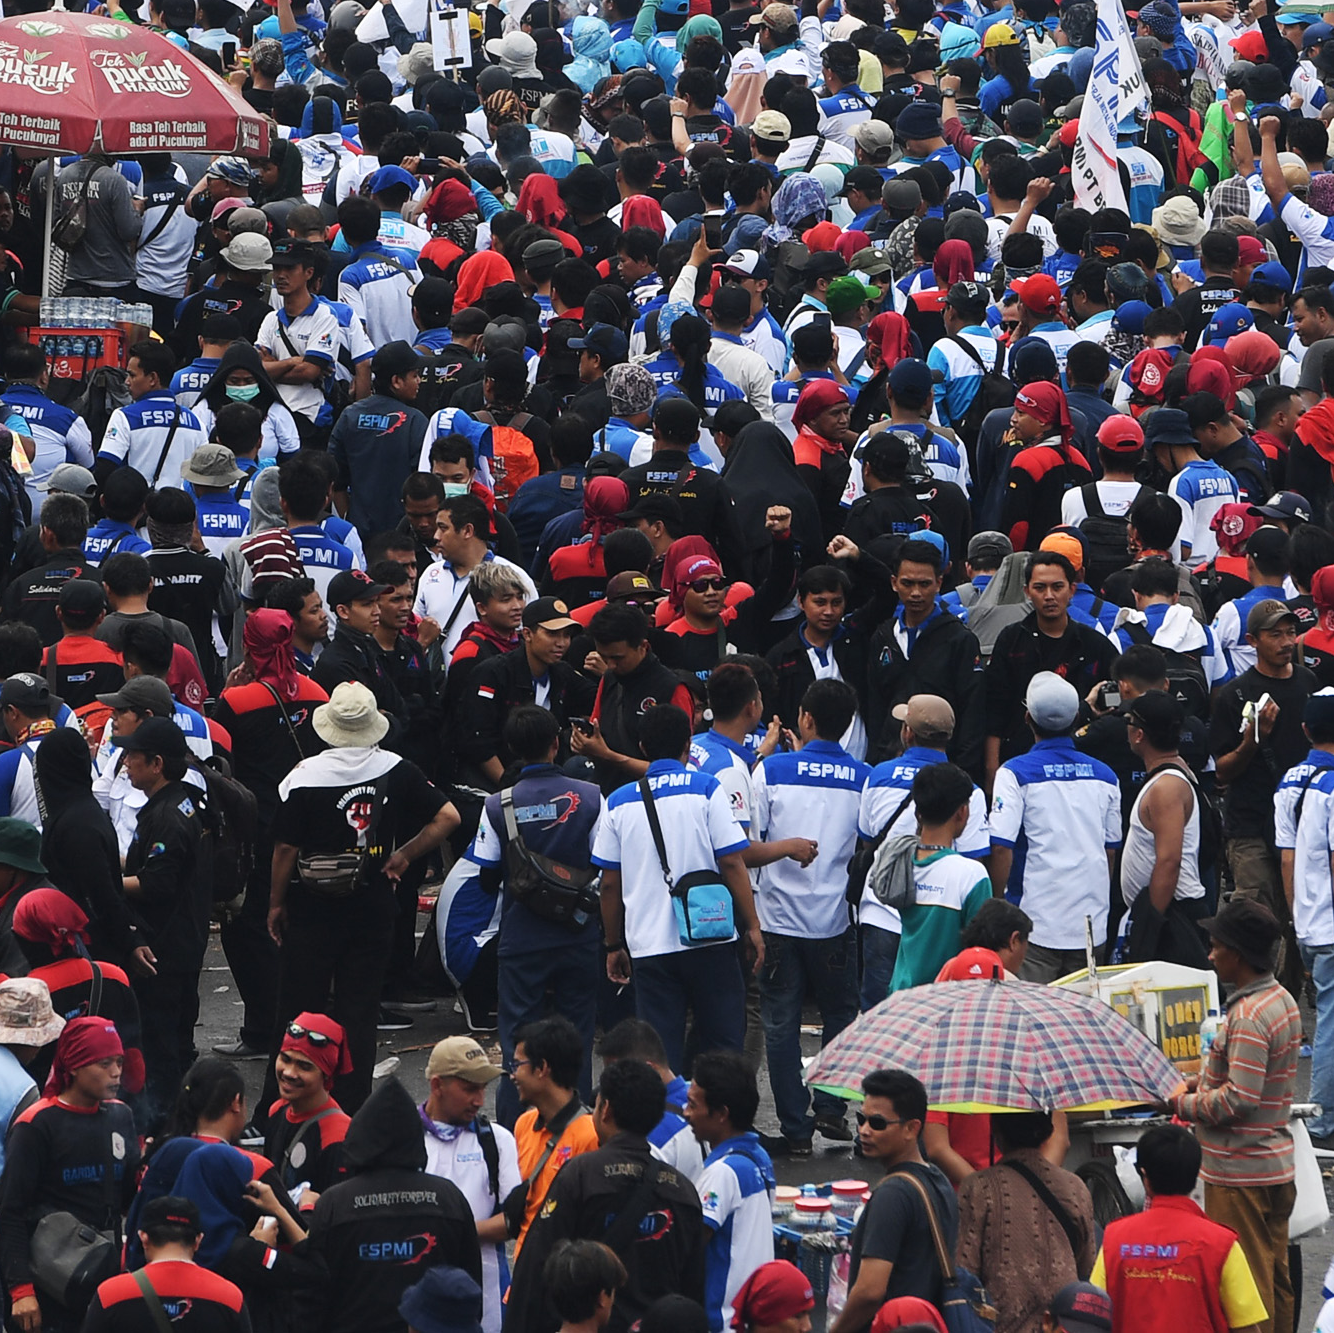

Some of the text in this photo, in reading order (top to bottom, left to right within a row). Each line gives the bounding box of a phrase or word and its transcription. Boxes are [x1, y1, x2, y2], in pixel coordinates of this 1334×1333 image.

[91, 50, 127, 68] Teh
[101, 59, 192, 94] pucuk
[122, 80, 190, 94] HARUM
[20, 113, 61, 132] Terbaik
[129, 120, 207, 134] Rasa Teh Terbaik
[3, 127, 60, 146] Pucuknya!
[129, 134, 207, 148] ada di Pucuknya!
[358, 413, 390, 431] FSPMI
[202, 513, 242, 529] FSPMI
[688, 559, 711, 575] FSPMI
[797, 760, 856, 783] FSPMI
[1042, 762, 1096, 778] FSPMI
[354, 1190, 439, 1209] SOLIDARITY FOREVER
[359, 1241, 414, 1258] FSPMI
[1119, 1244, 1179, 1258] FSPMI
